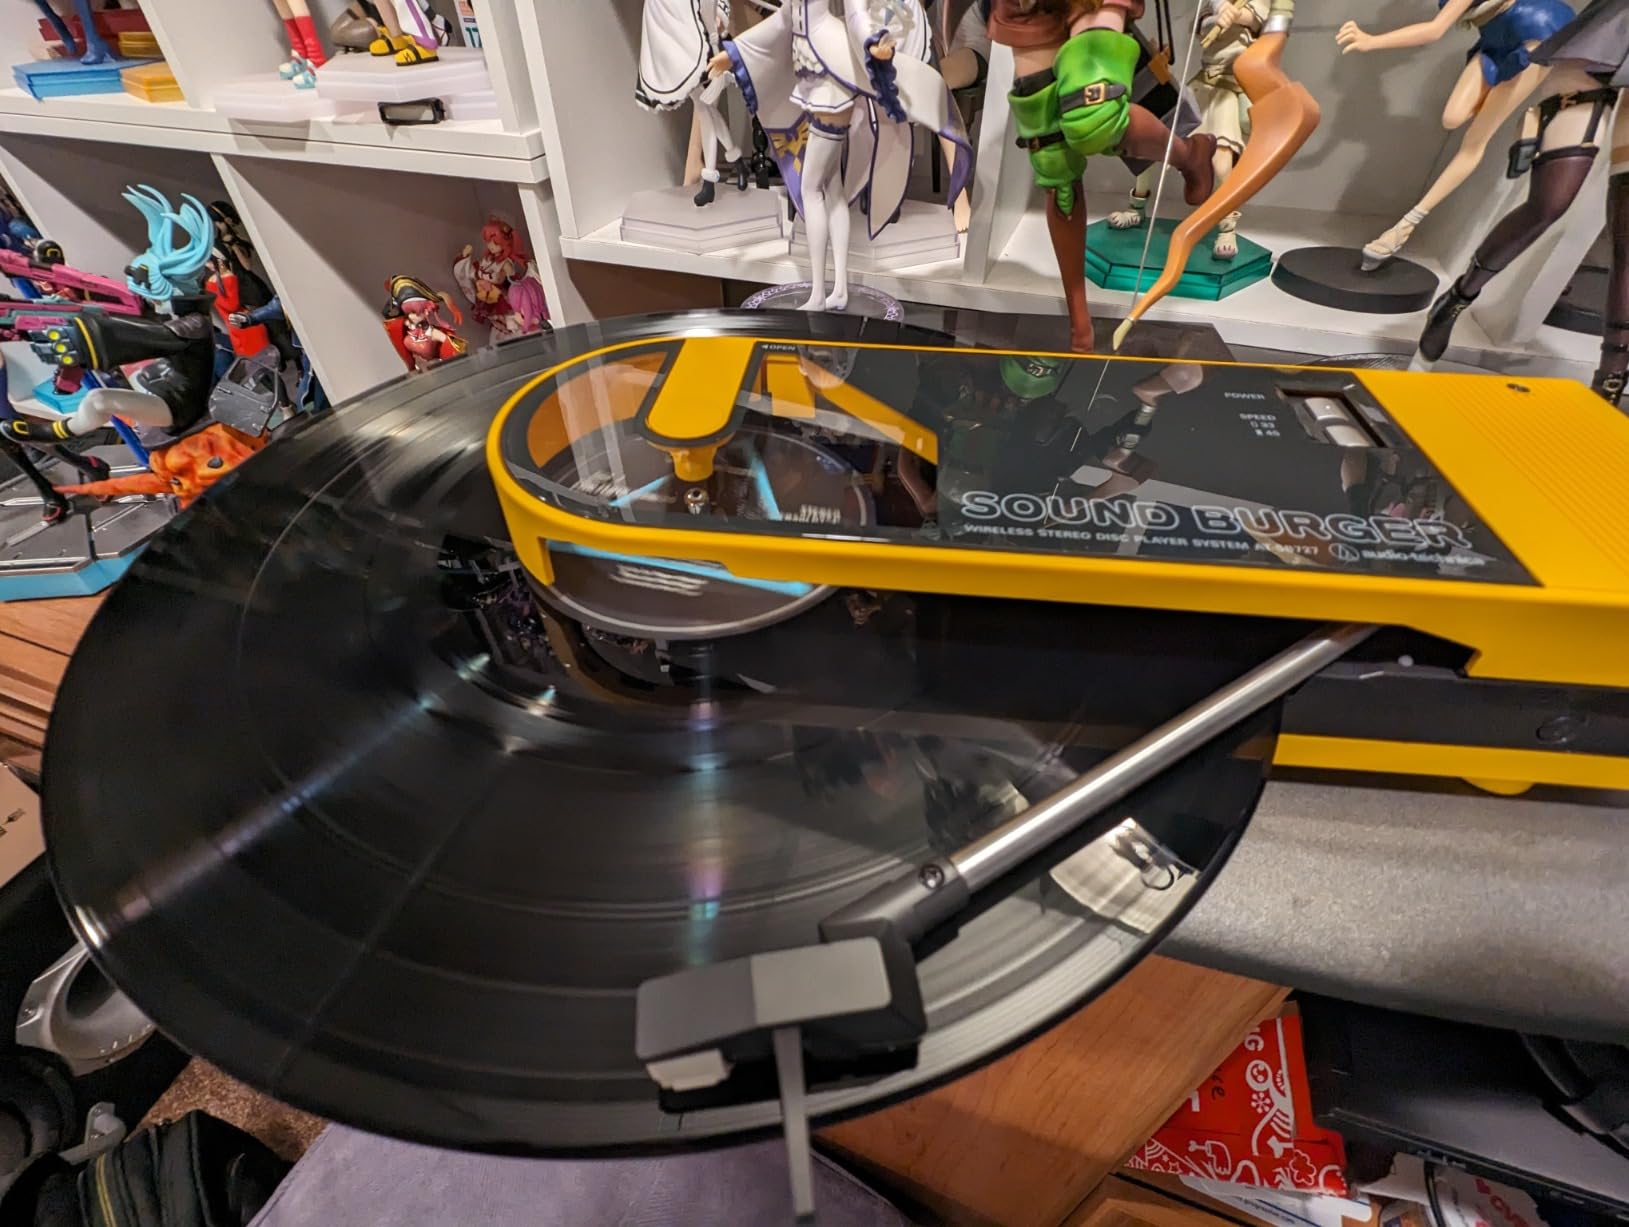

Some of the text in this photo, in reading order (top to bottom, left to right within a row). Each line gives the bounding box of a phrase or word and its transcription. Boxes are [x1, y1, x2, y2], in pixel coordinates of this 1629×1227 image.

[1224, 391, 1265, 400] POWER
[1240, 413, 1276, 421] SPEED
[961, 490, 1473, 550] SOUND BURGER
[964, 523, 1033, 537] WIRELESS
[1037, 528, 1091, 541] STEREO
[1096, 532, 1130, 543] DISC
[1134, 534, 1189, 547] PLAYER
[1193, 538, 1249, 551] SYSTEM
